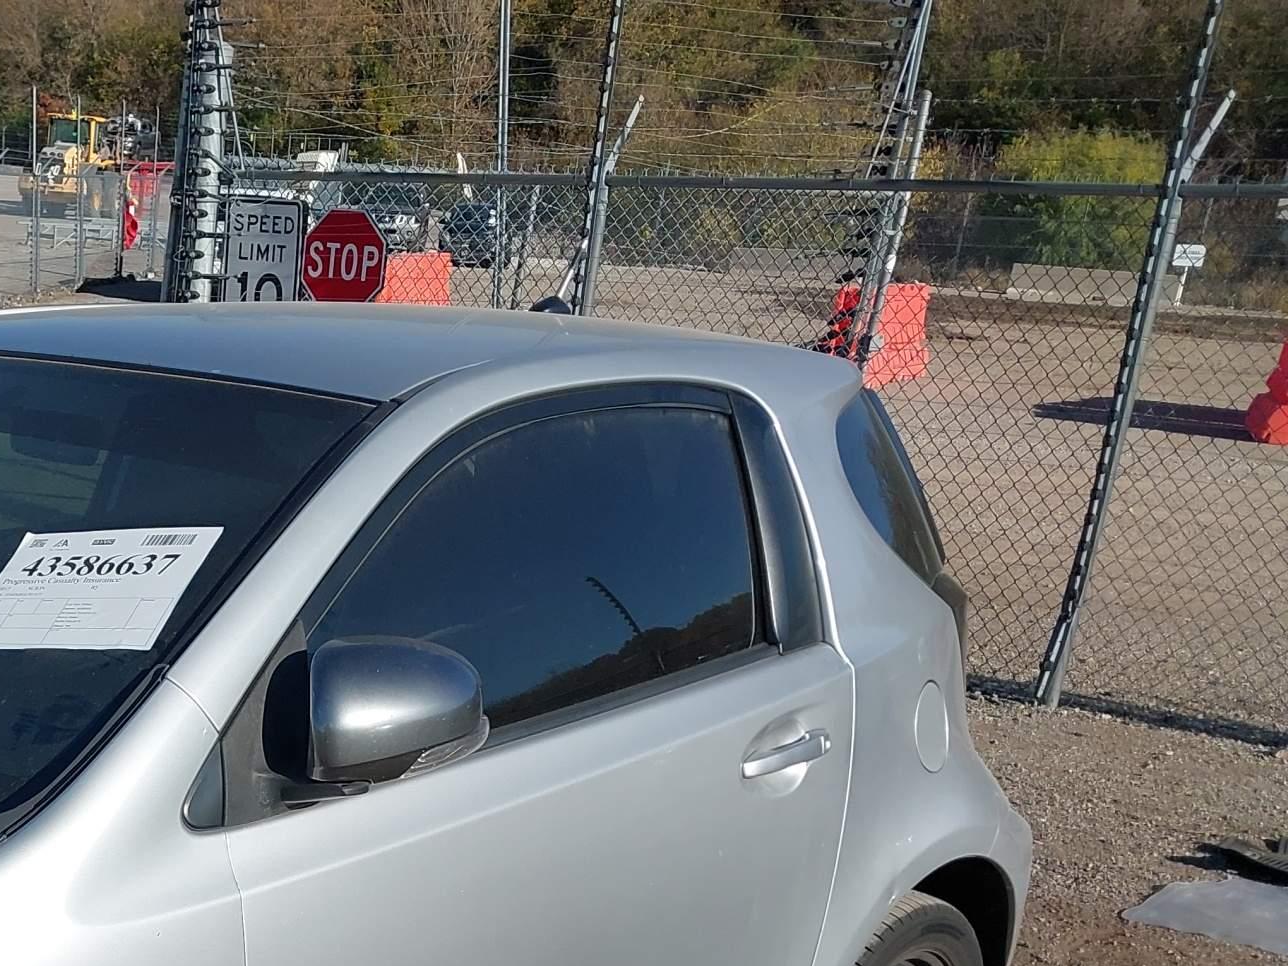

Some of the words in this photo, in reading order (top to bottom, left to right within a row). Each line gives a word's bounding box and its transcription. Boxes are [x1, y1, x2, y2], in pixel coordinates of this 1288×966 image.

[233, 213, 295, 235] SPEED
[238, 241, 287, 263] LIMIT
[307, 240, 379, 282] STOP
[236, 271, 283, 302] 10
[20, 553, 182, 577] 43586637
